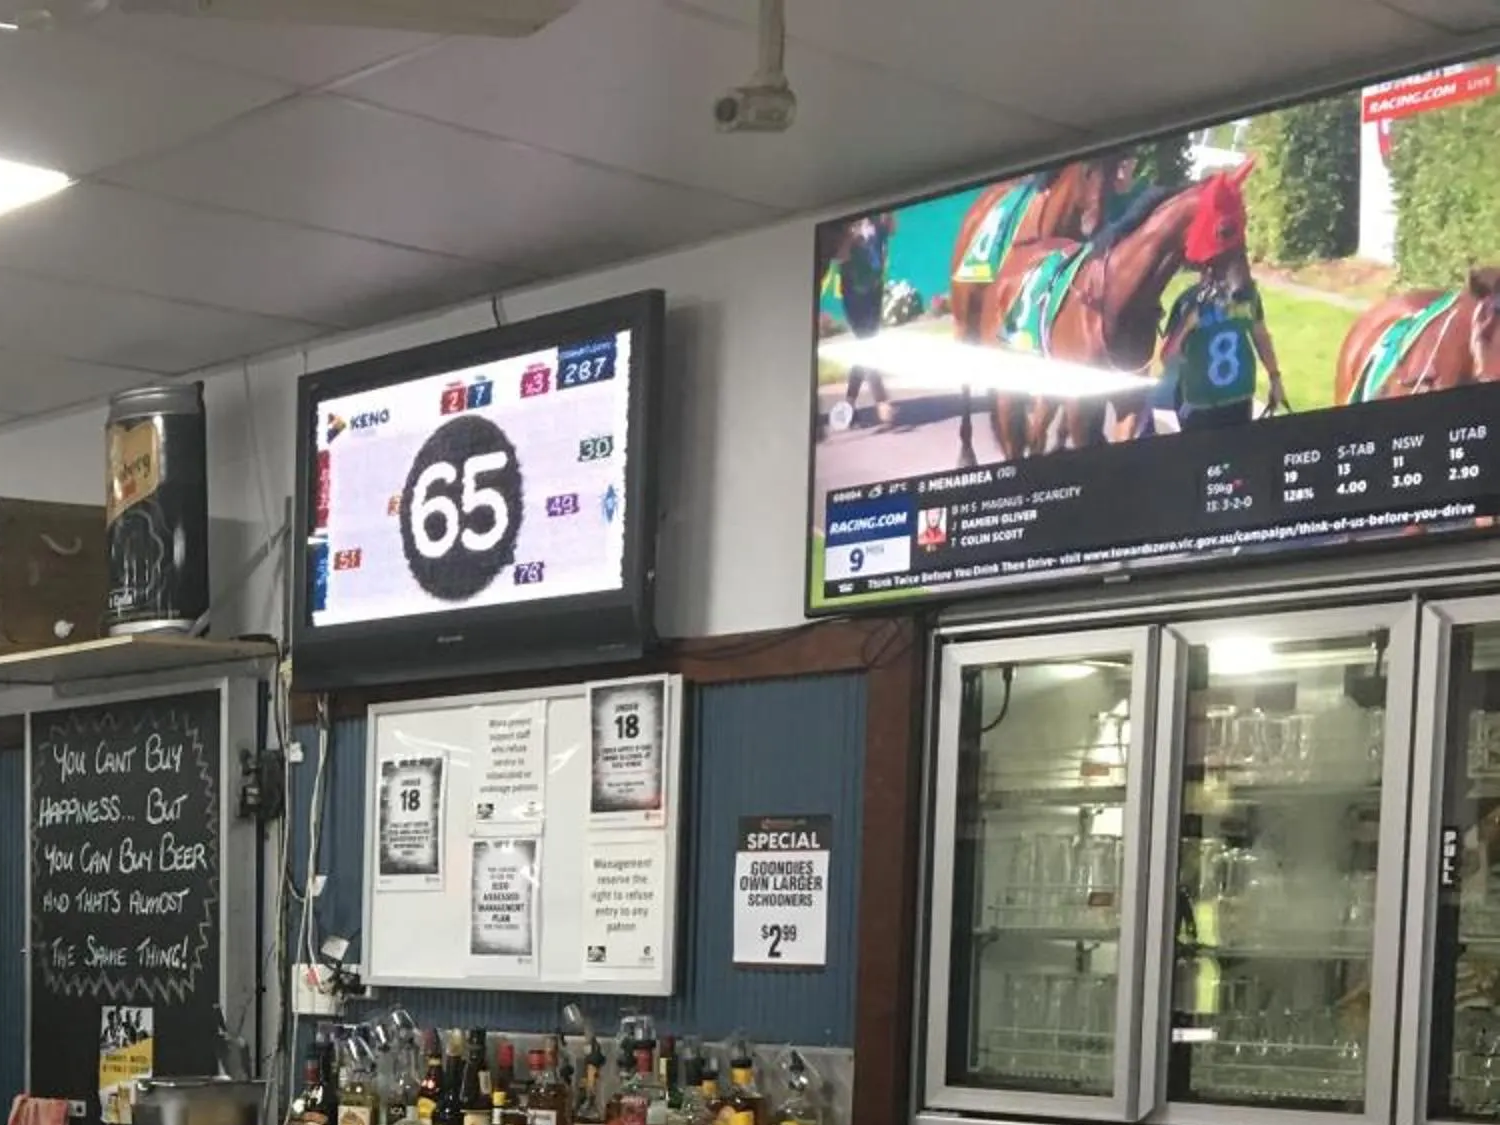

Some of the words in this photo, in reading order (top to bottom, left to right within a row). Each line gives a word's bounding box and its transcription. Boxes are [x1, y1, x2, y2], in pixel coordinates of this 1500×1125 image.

[1208, 331, 1239, 386] 8
[565, 357, 607, 385] 287
[349, 409, 390, 430] KENO
[1449, 425, 1487, 442] UTAB
[581, 438, 610, 461] 30
[1337, 441, 1375, 459] S-TAB
[1392, 435, 1425, 451] NSW
[1283, 450, 1321, 466] FIXED
[1449, 447, 1464, 460] 16
[928, 470, 993, 491] MENABREA
[1284, 470, 1298, 484] 19
[1392, 472, 1422, 488] 3.00
[1448, 464, 1480, 480] 2.90
[1336, 480, 1367, 494] 4.00
[409, 451, 509, 558] 65
[829, 511, 907, 535] RACING.COM
[961, 515, 999, 530] DAMIEN
[1001, 509, 1037, 524] OLIVER
[960, 533, 991, 547] COLIN
[991, 528, 1024, 542] SCOTT
[849, 548, 864, 572] 9
[614, 714, 639, 738] 18
[401, 790, 421, 811] 18
[748, 831, 820, 849] SPECIAL
[751, 860, 814, 876] GOONDIES
[740, 877, 769, 892] OWN
[773, 876, 823, 892] LARGER
[748, 893, 813, 907] SCHOONERS
